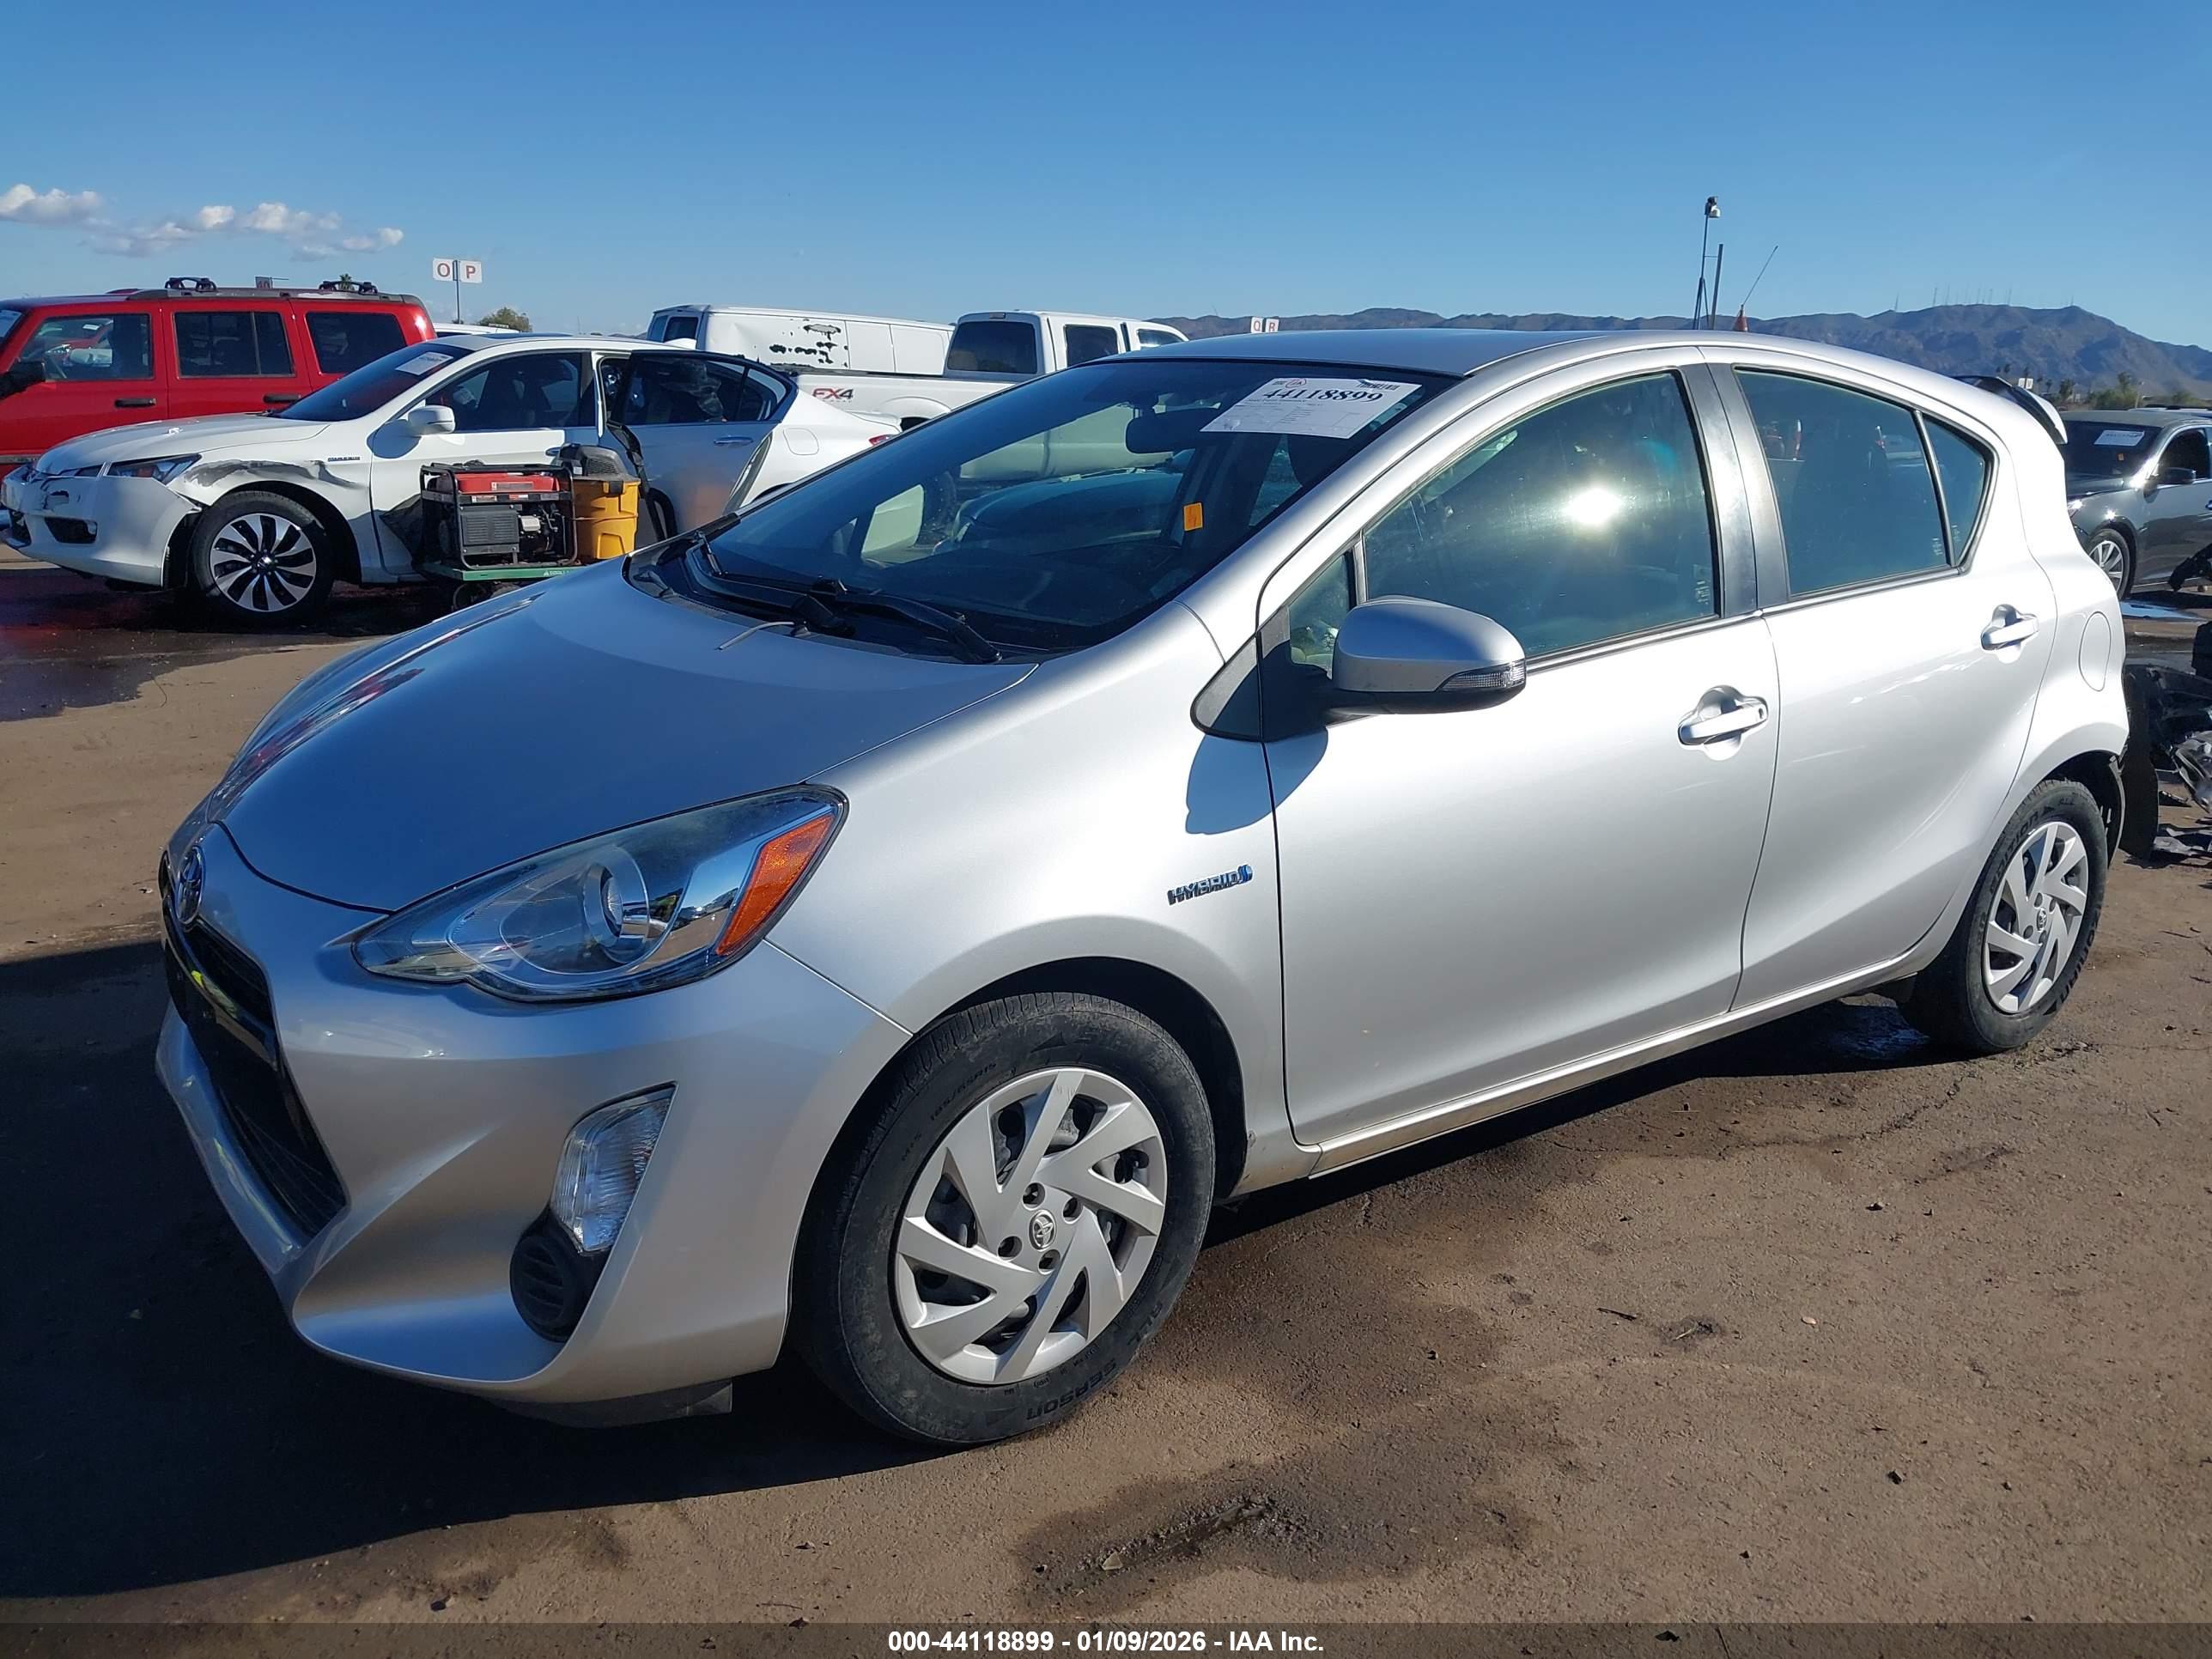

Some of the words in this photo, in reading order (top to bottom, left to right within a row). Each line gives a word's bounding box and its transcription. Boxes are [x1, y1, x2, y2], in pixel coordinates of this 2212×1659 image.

[466, 264, 476, 279] P
[1269, 322, 1276, 331] R
[812, 387, 854, 399] FX4
[1262, 388, 1383, 403] 44118899
[1167, 870, 1243, 906] HYBRID
[1026, 1358, 1117, 1421] SEASON
